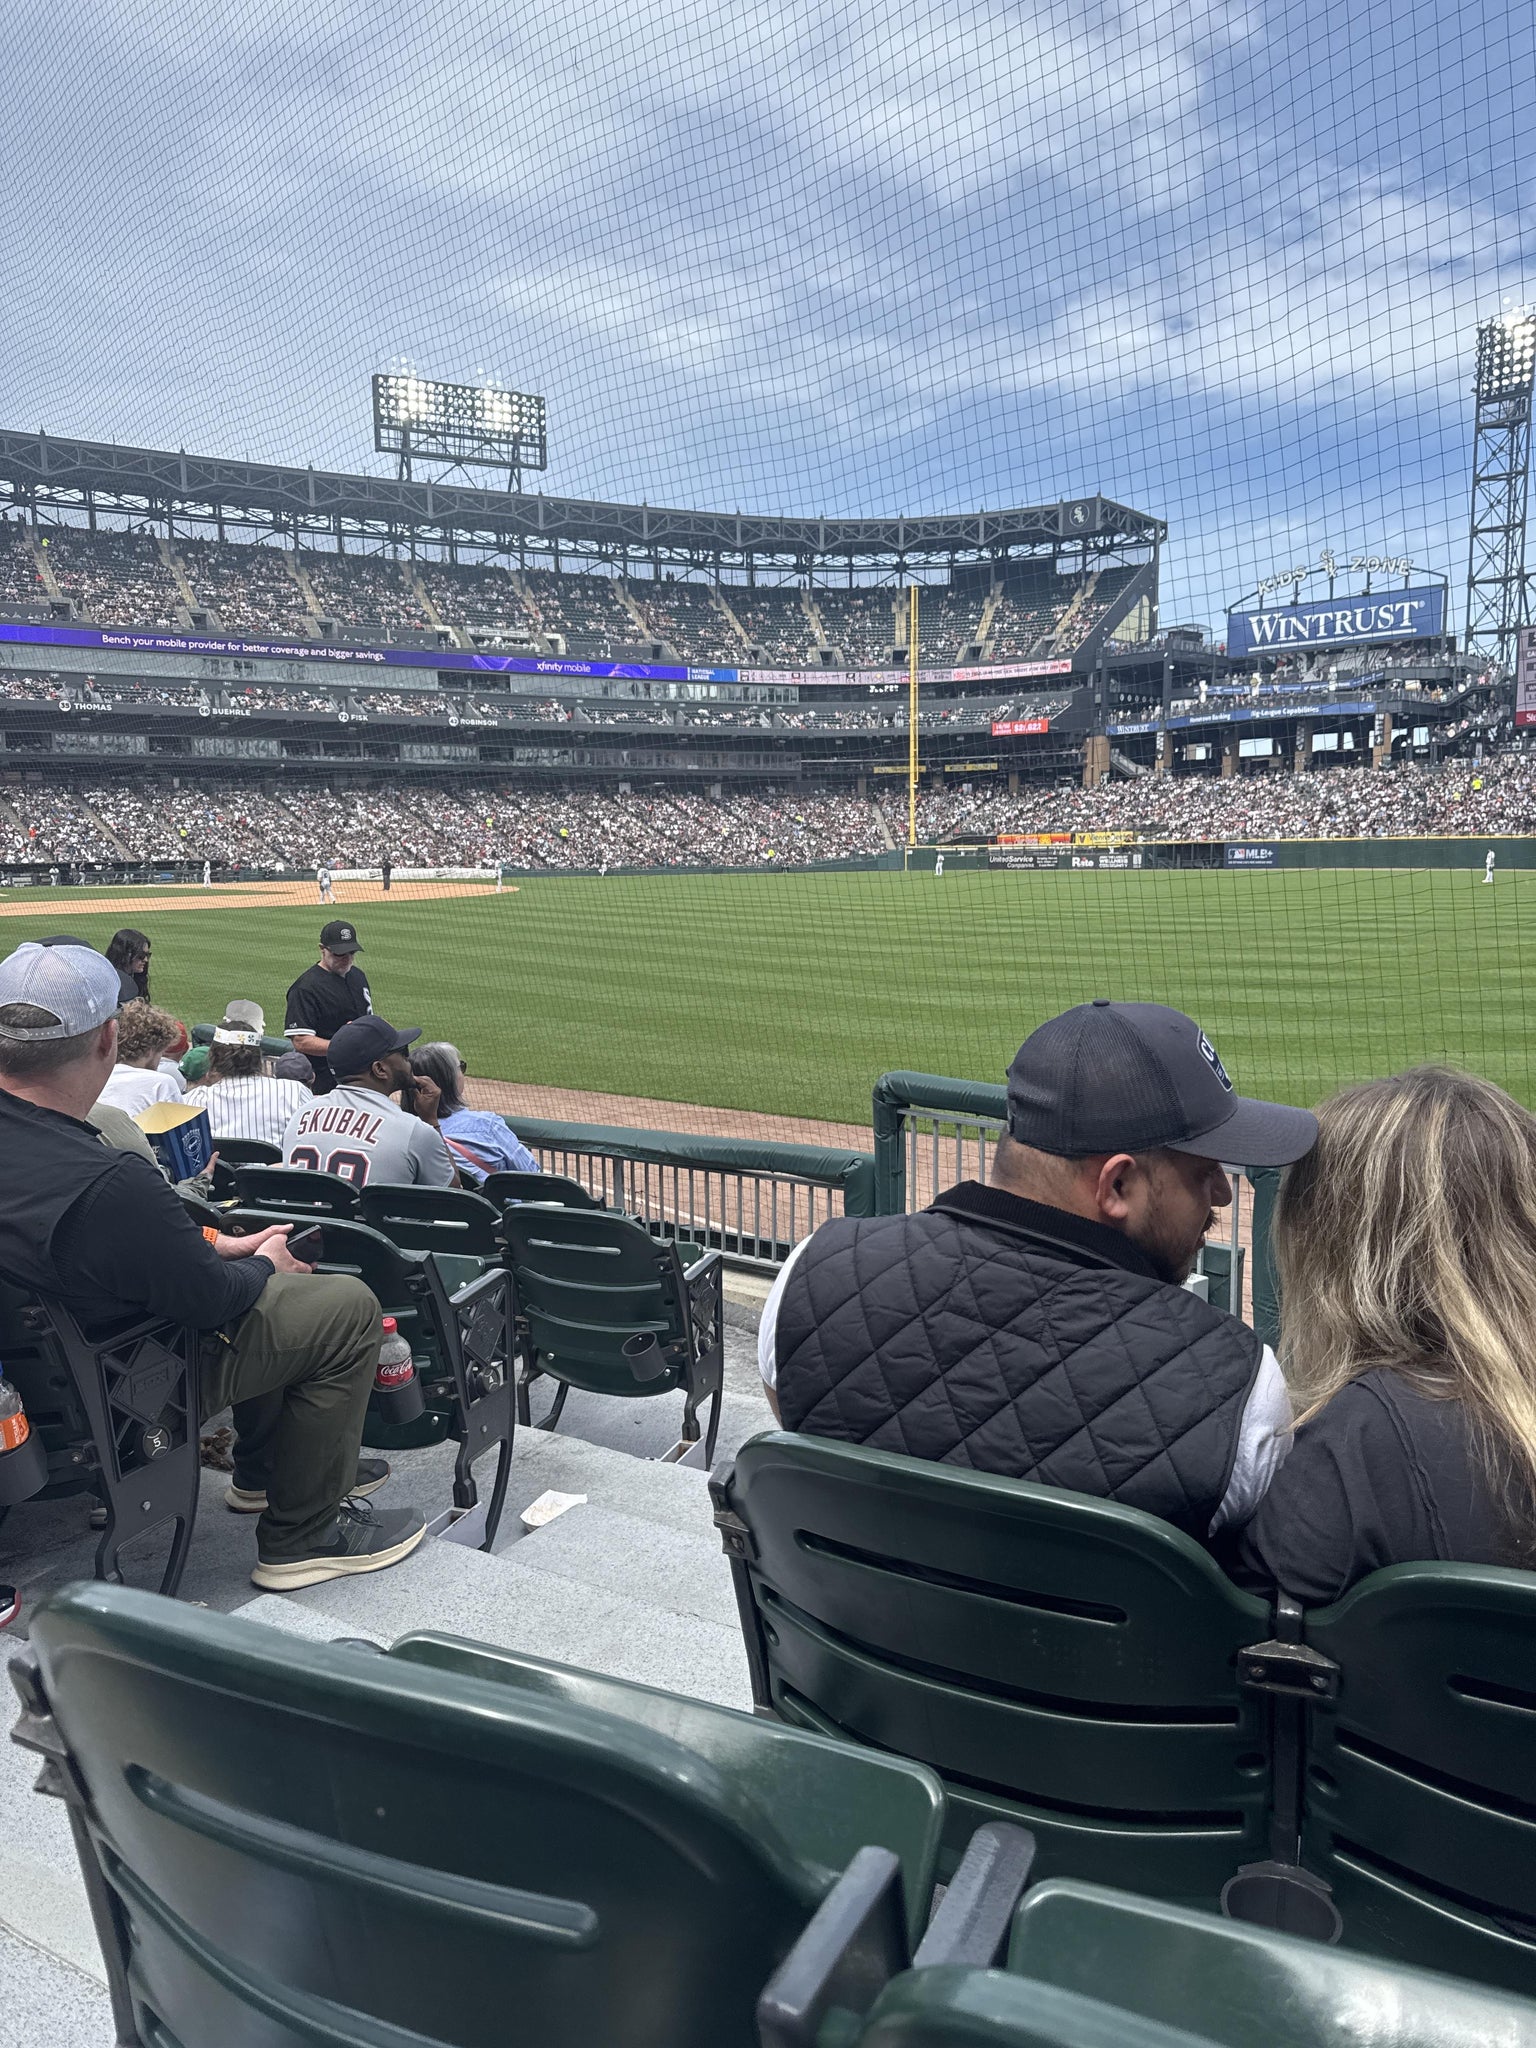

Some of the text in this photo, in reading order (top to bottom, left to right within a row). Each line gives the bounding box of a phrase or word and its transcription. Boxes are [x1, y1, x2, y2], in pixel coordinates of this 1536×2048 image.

[1257, 566, 1307, 596] KIDS
[1350, 556, 1414, 576] ZONE
[102, 634, 386, 661] Bench your mobile provider for better coverage and bigger savings.
[536, 661, 591, 673] xfinity mobile
[691, 668, 715, 676] NATIONAL
[73, 702, 112, 711] THOMAS
[1283, 706, 1319, 716] Capabilities
[212, 707, 251, 717] BUEHRLE
[350, 714, 369, 722] FISK
[460, 718, 498, 727] ROBINSON
[297, 1106, 384, 1147] SKUBAL
[153, 1437, 161, 1447] 5
